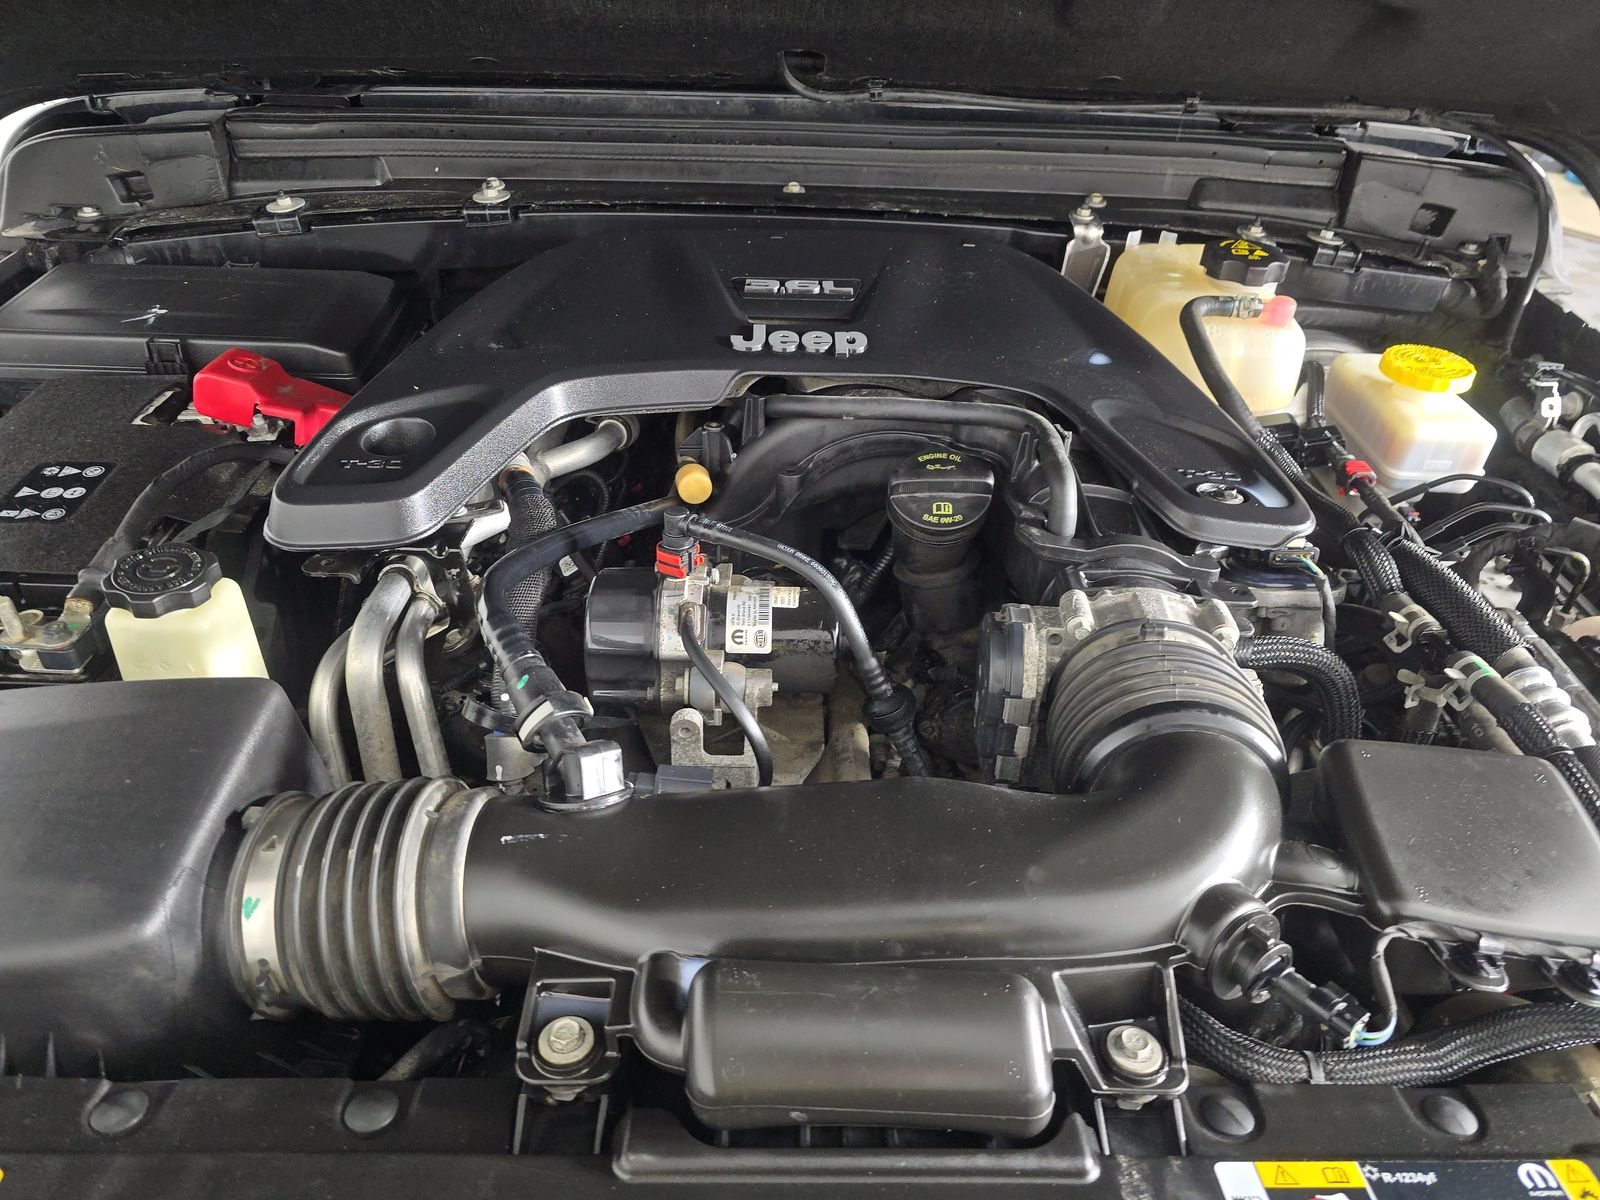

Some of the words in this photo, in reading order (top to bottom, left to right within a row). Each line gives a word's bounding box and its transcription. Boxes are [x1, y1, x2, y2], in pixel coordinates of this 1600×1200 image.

[744, 279, 854, 295] 3.6L
[730, 324, 868, 357] Jeep
[917, 453, 947, 462] ENGINE
[949, 453, 962, 462] OIL
[922, 513, 939, 523] SAE
[940, 514, 963, 523] 0W-20
